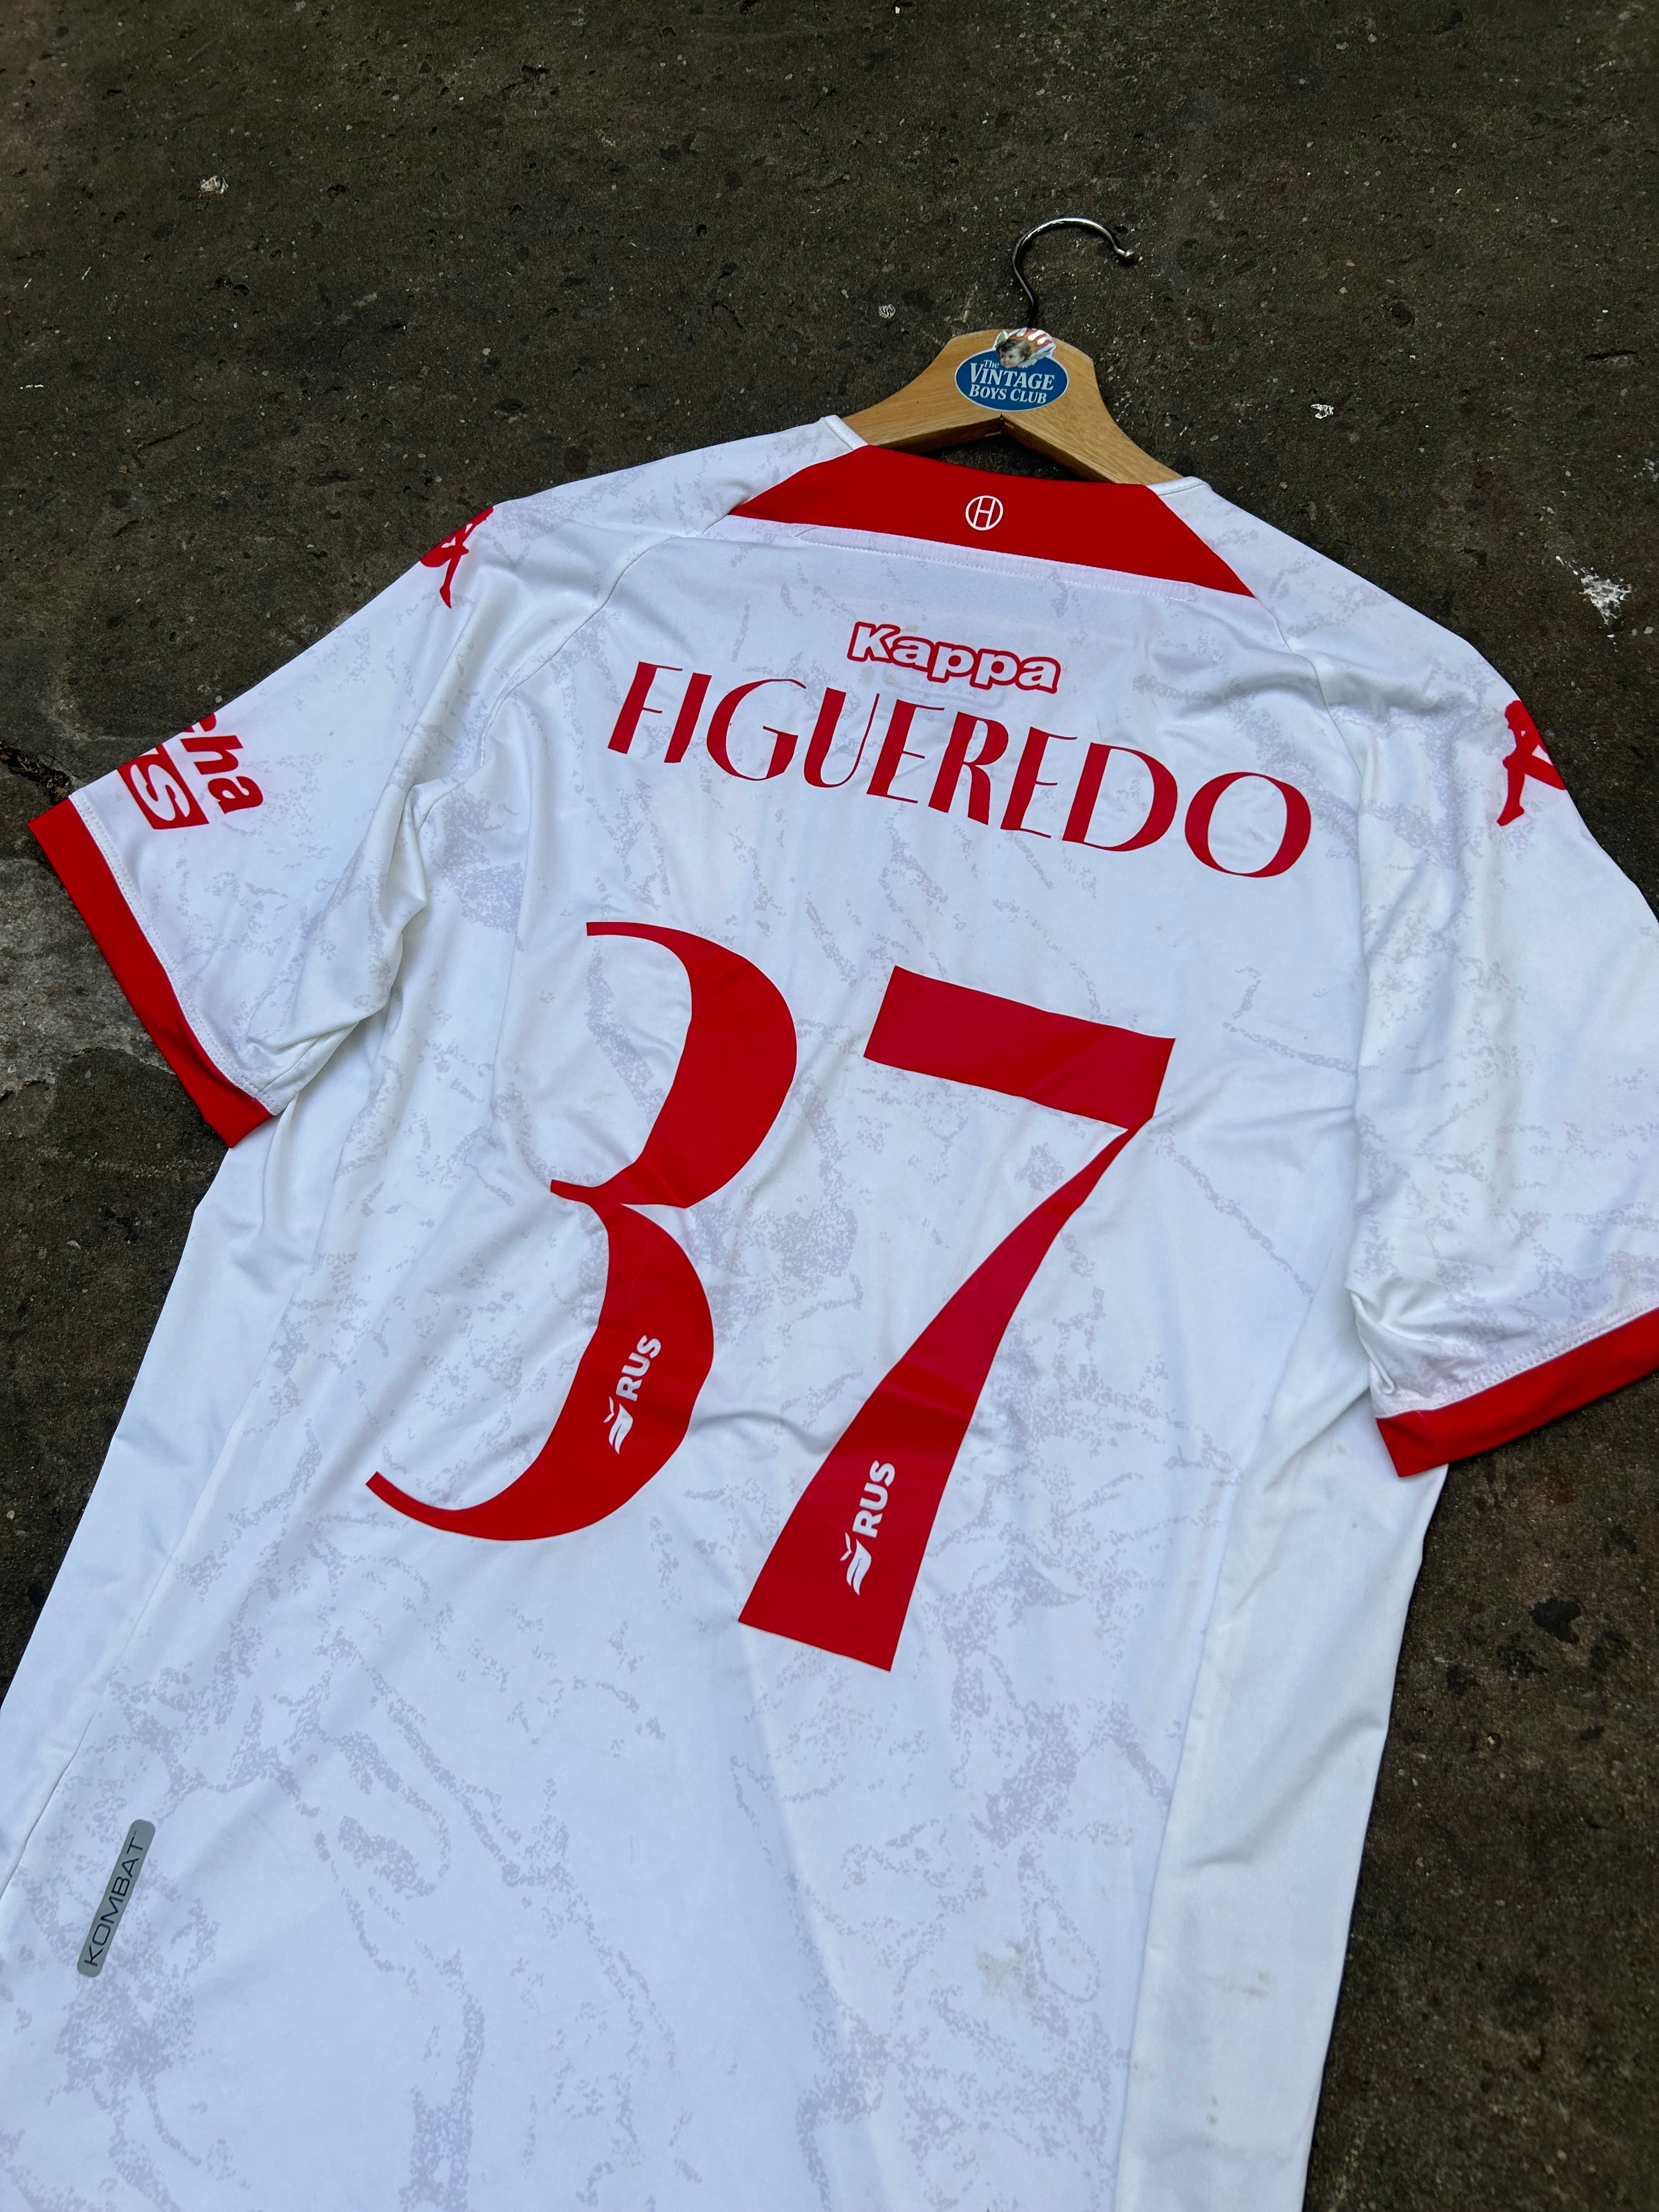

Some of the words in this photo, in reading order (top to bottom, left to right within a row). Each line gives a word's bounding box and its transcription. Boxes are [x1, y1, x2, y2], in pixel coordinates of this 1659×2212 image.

[969, 385, 1007, 400] BOYS
[1010, 389, 1047, 404] CLUB
[970, 363, 1054, 391] VINTAGE
[983, 359, 1000, 369] The
[845, 620, 1063, 695] Kappa
[607, 661, 1312, 879] FIGUEREDO
[366, 921, 1176, 1672] 37
[616, 1334, 662, 1402] RUS
[852, 1460, 896, 1538] RUS
